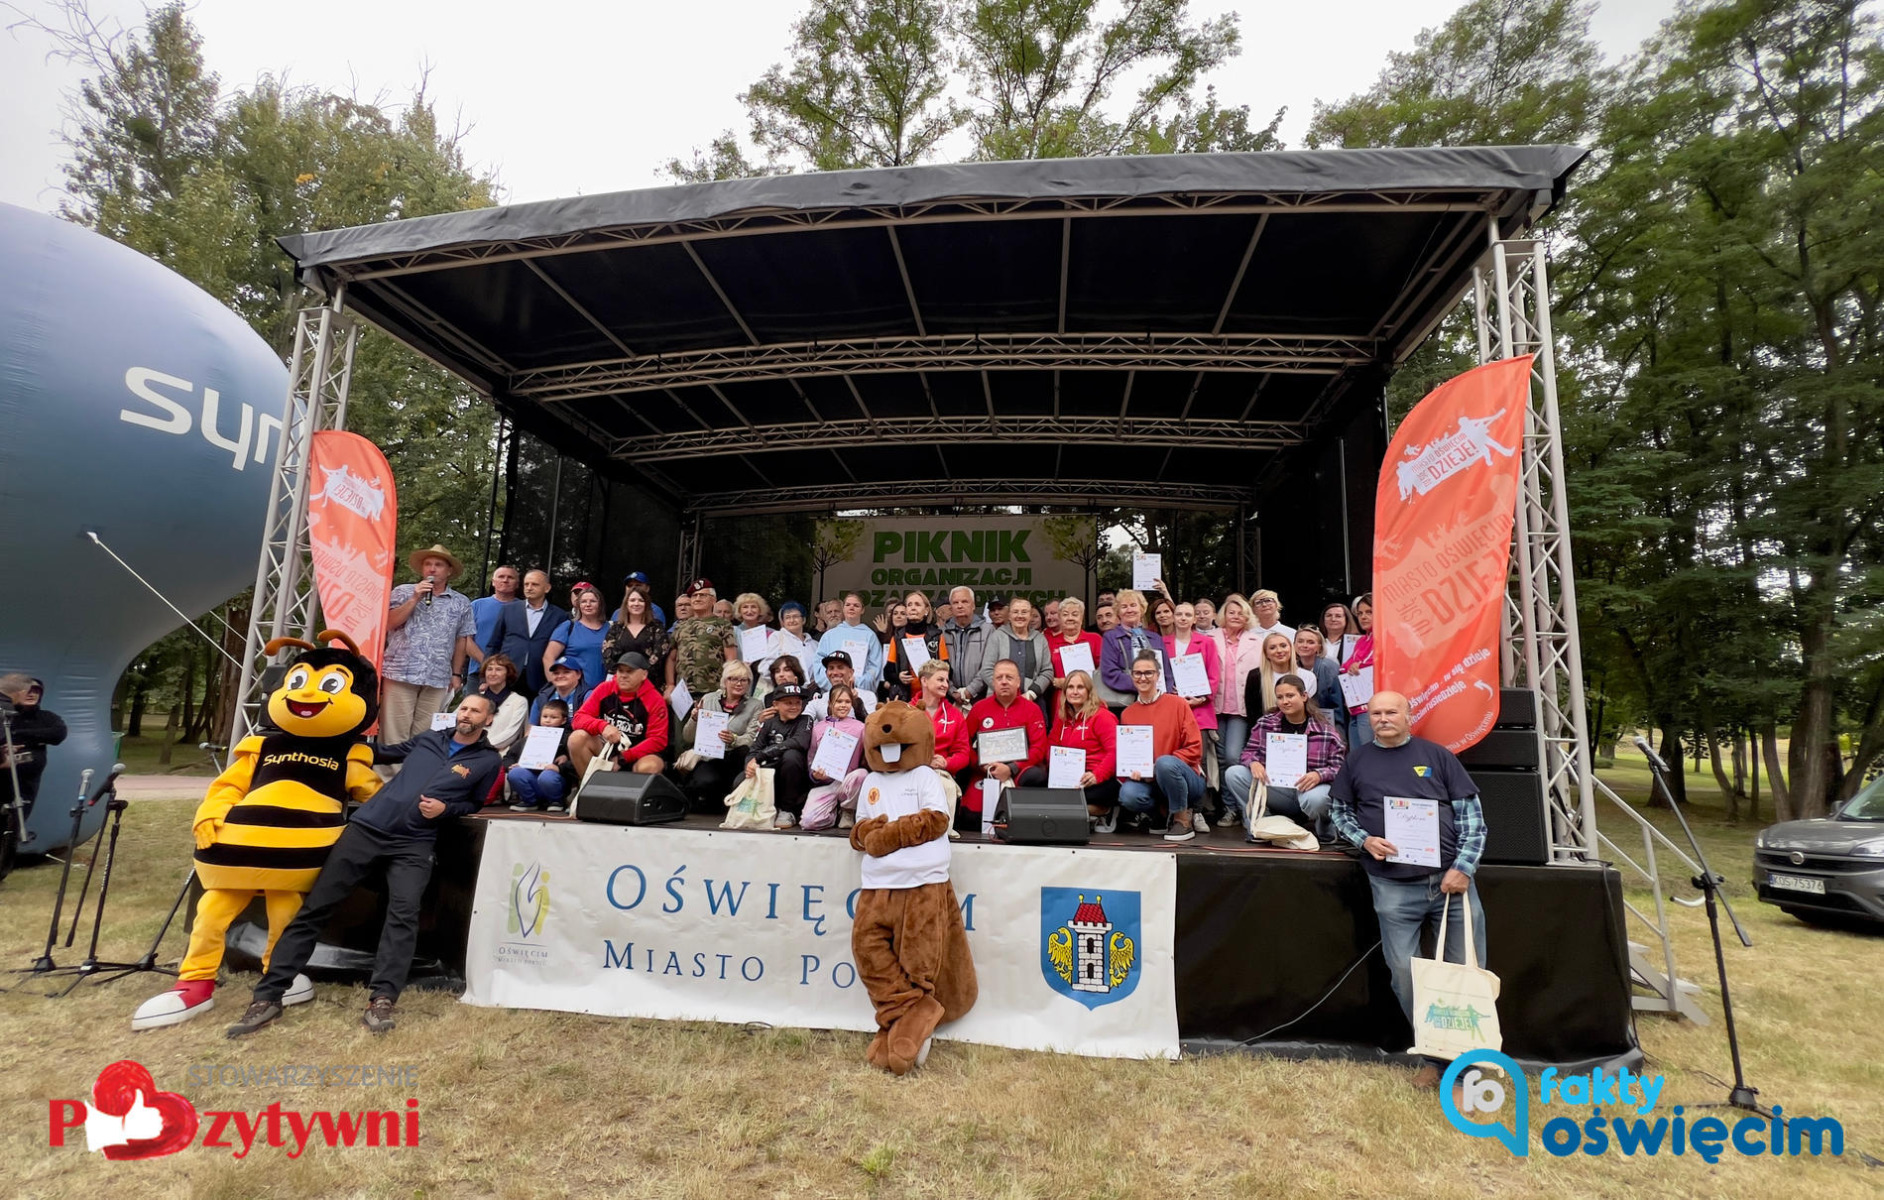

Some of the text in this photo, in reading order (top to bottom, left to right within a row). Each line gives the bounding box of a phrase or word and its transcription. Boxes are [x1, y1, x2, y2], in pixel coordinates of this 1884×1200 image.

[1427, 439, 1480, 480] DZIEJE!
[873, 530, 1032, 563] PIKNIK
[1382, 513, 1512, 604] MIASTO OŚWIĘCIM
[871, 568, 1032, 585] ORGANIZACJI
[1462, 647, 1491, 668] dzieje
[603, 940, 764, 981] MIASTO
